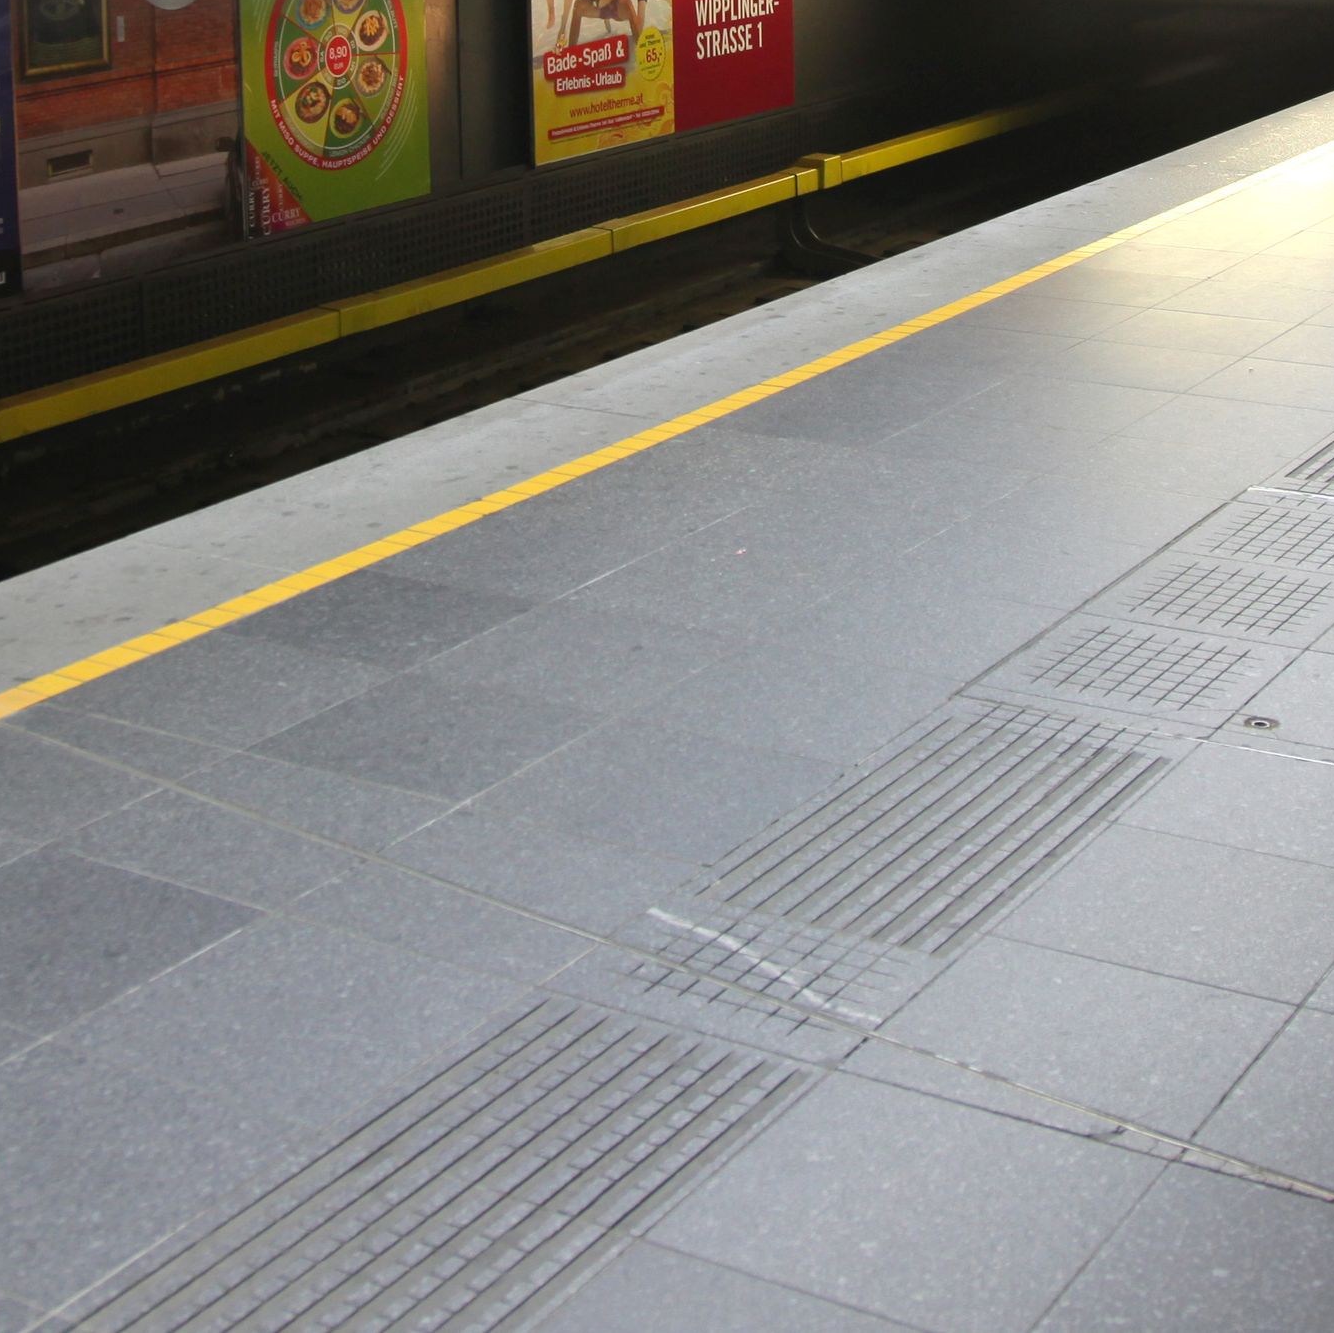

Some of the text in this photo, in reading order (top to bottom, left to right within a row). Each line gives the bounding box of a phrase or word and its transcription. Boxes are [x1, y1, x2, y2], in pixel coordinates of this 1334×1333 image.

[329, 45, 348, 62] 8,90
[615, 40, 625, 58] &
[696, 21, 763, 60] STRASSE 1
[569, 92, 644, 118] www.hoteltherme.at
[269, 98, 282, 122] MIT
[278, 120, 295, 146] MISO
[293, 143, 320, 167] SUPPE,
[322, 142, 373, 169] HAUPTSPEISE
[372, 125, 387, 145] UND
[386, 74, 405, 124] DESSERT
[262, 187, 271, 236] CURRY
[271, 207, 300, 224] CURRY
